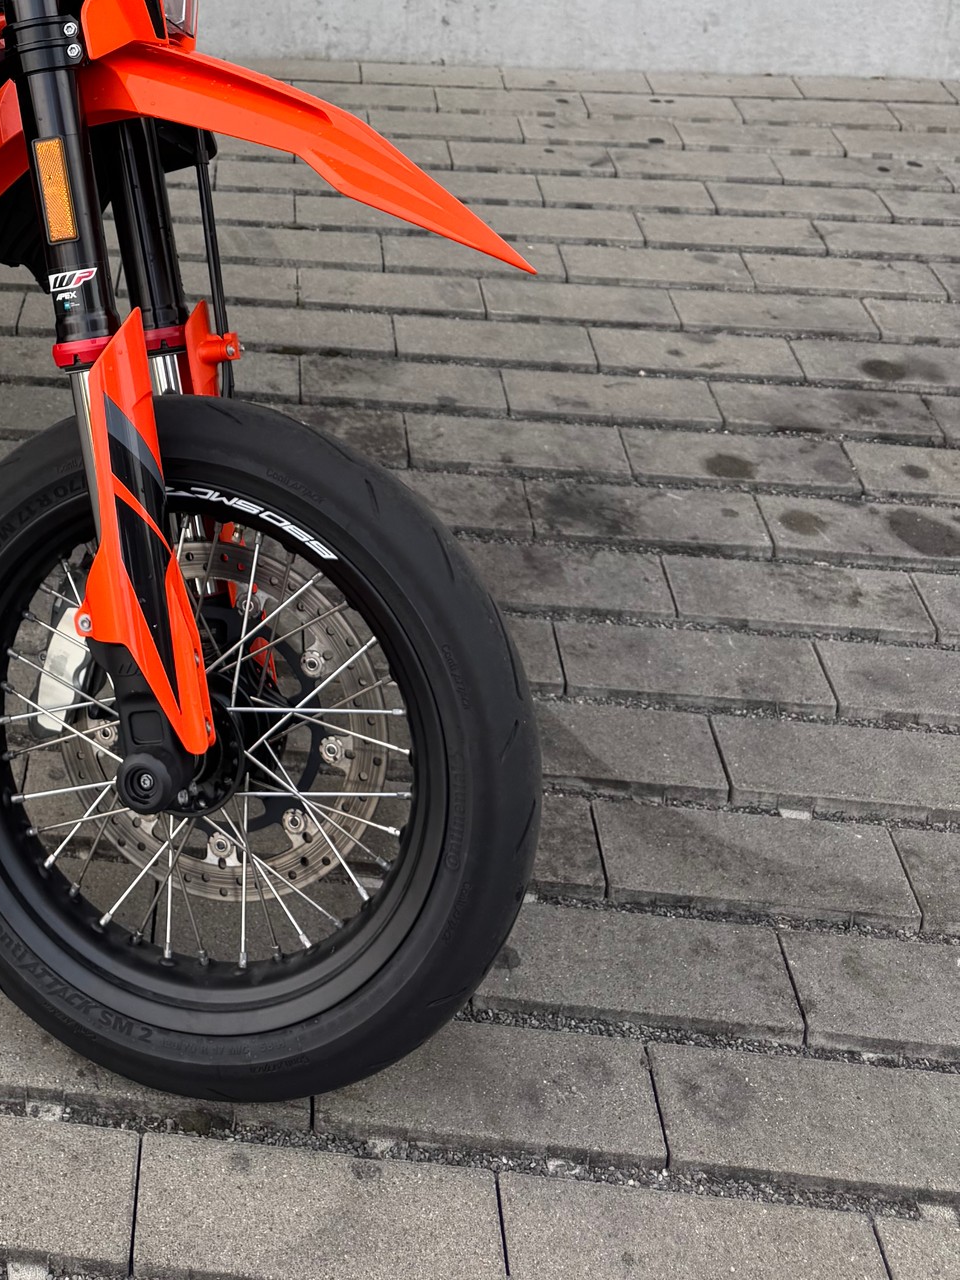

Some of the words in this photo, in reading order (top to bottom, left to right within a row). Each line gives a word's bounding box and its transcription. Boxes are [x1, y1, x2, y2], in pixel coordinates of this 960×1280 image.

[49, 268, 97, 291] WP
[56, 291, 77, 301] APEX
[190, 487, 265, 515] SMC
[259, 511, 338, 560] 690
[98, 1010, 135, 1037] SM
[139, 1026, 153, 1044] 2
